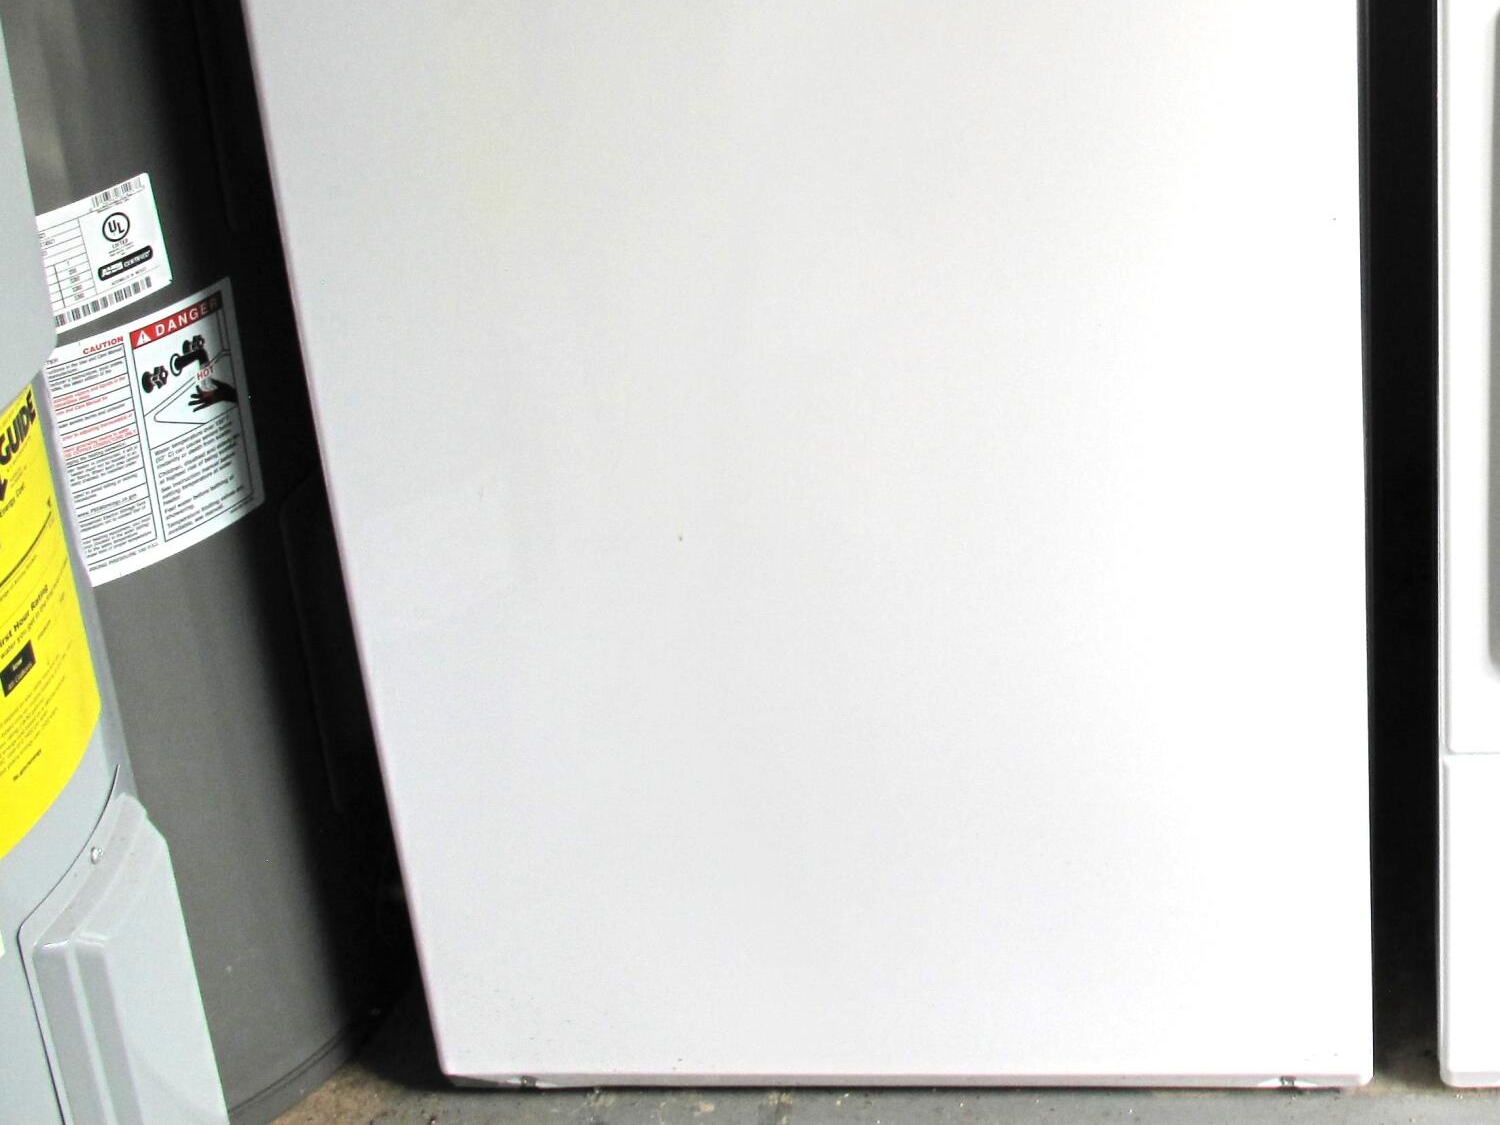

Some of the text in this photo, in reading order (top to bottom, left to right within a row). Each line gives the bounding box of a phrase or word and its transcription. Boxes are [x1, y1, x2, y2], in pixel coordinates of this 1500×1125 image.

[108, 219, 125, 235] UL
[156, 297, 218, 337] DANGER
[82, 335, 124, 355] CAUTION
[197, 365, 214, 380] HOT
[0, 389, 36, 466] GUIDE
[14, 609, 30, 633] Hour
[31, 583, 48, 611] Rating
